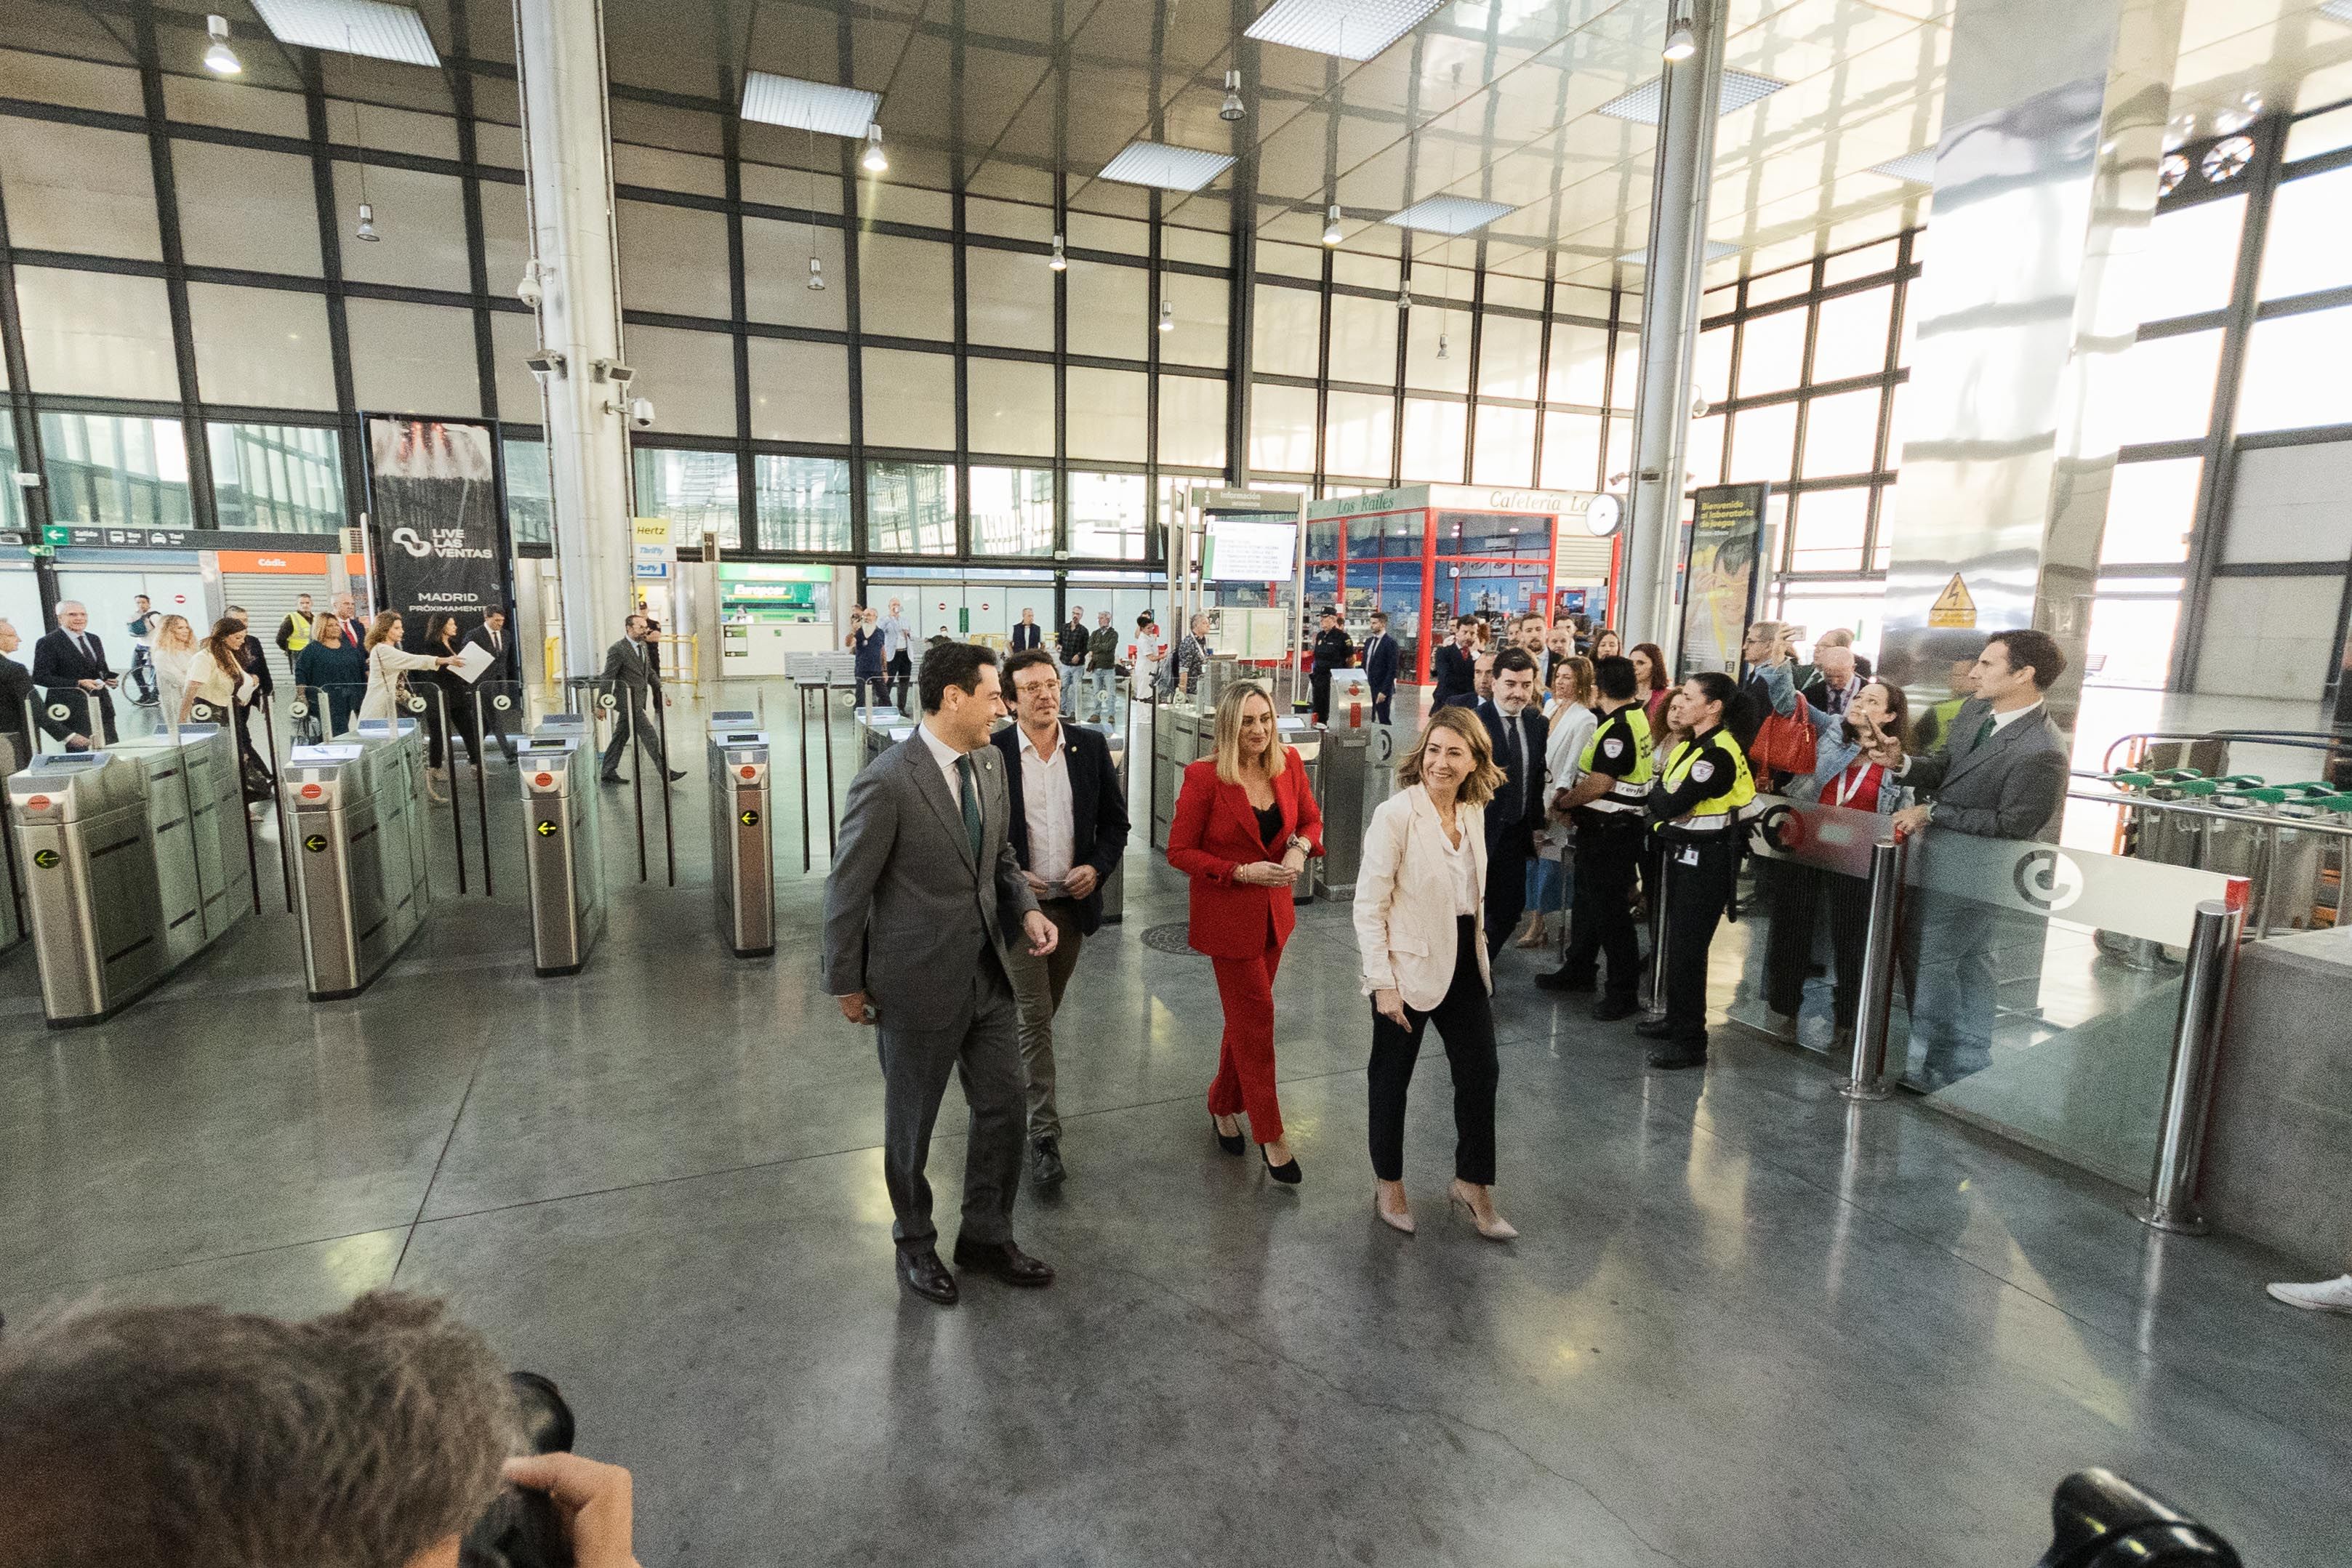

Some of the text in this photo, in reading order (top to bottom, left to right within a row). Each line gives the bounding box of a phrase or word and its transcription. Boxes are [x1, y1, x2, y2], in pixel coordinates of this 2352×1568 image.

[1338, 499, 1355, 514] Los
[1361, 494, 1394, 511] Railes
[1490, 491, 1589, 512] Cafetería Lo
[432, 528, 465, 538] LIVE
[433, 539, 463, 548] LAS
[435, 548, 493, 558] VENTAS
[418, 592, 479, 602] MADRID
